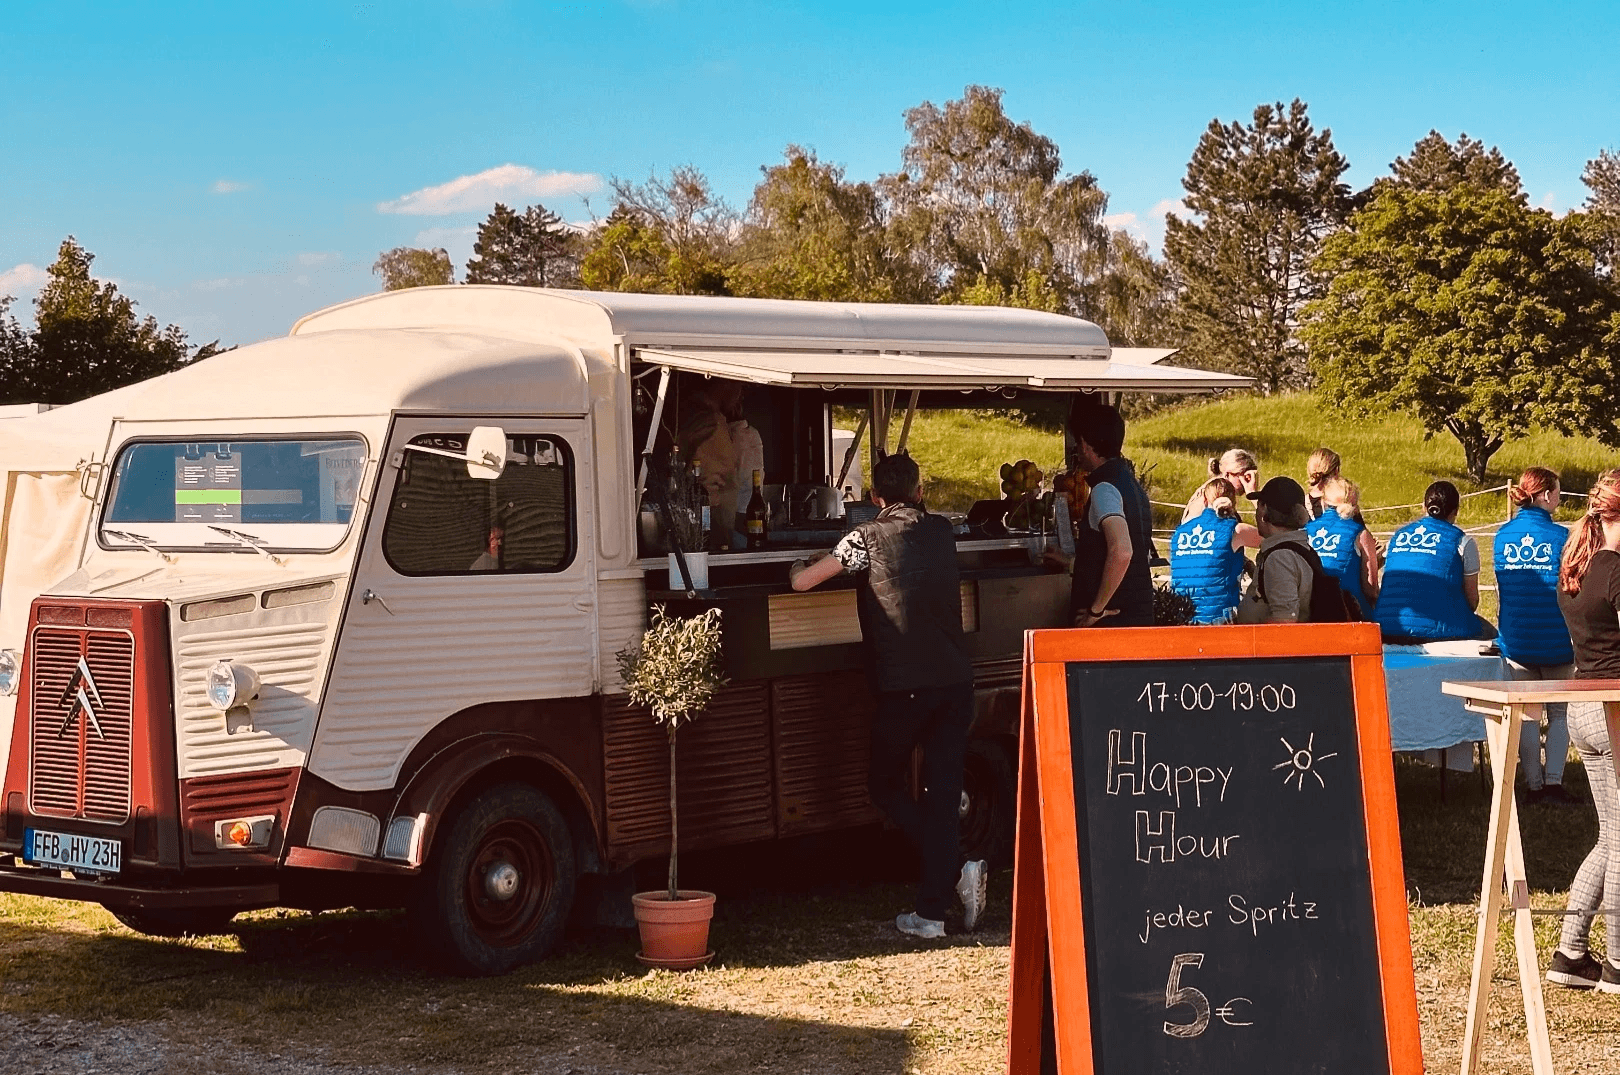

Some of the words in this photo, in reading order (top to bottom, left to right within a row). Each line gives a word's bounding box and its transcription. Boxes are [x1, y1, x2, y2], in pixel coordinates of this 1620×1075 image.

[1137, 682, 1296, 713] 17:00-19:00
[1106, 729, 1233, 808] Happy
[33, 832, 60, 860] FFB
[70, 836, 89, 864] HY
[91, 840, 120, 869] 23H
[1135, 810, 1240, 863] Hour
[1139, 905, 1213, 943] jeder
[1228, 891, 1319, 936] Spritz
